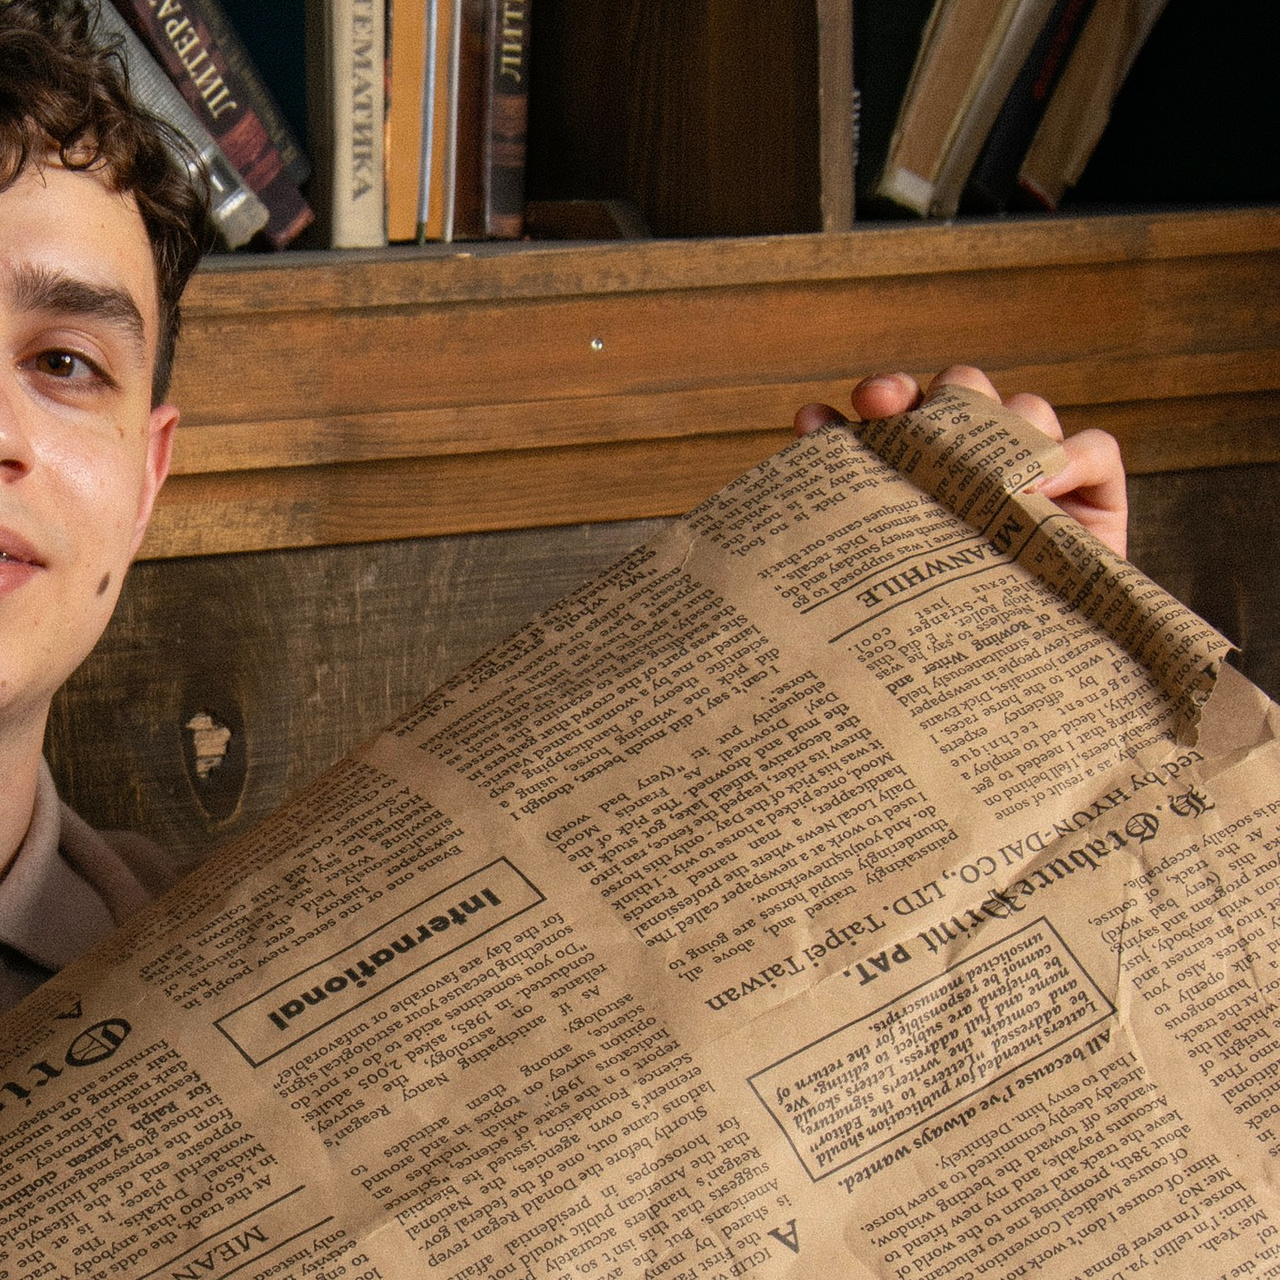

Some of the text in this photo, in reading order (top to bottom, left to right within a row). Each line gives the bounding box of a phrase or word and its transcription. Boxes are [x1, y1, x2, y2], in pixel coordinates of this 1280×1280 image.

[860, 519, 1024, 609] MEANWHILE
[990, 658, 1058, 693] journalist,
[919, 705, 961, 729] Evans
[959, 691, 992, 710] Dick
[1097, 708, 1105, 717] I
[973, 748, 1020, 775] employ
[1023, 739, 1038, 750] to
[1130, 768, 1167, 791] by
[998, 787, 1131, 865] HYUN-DAI
[942, 856, 996, 883] CO.,
[882, 880, 945, 915] LTD.
[802, 913, 886, 967] Taipei
[267, 886, 503, 1034] International
[843, 943, 911, 985] PAT.
[704, 955, 805, 1010] Taiwan
[810, 990, 1089, 1152] be addressed "Letters to the Editor"
[815, 1001, 1097, 1167] Latters intended for publication should
[126, 1069, 200, 1114] featuring
[837, 1028, 1109, 1193] All because I've always wanted.
[36, 1118, 117, 1170] old-money
[776, 1194, 791, 1206] is
[720, 1206, 768, 1239] shared
[736, 1232, 760, 1248] the
[766, 1218, 799, 1253] A
[695, 1237, 716, 1252] by
[698, 1246, 736, 1270] First
